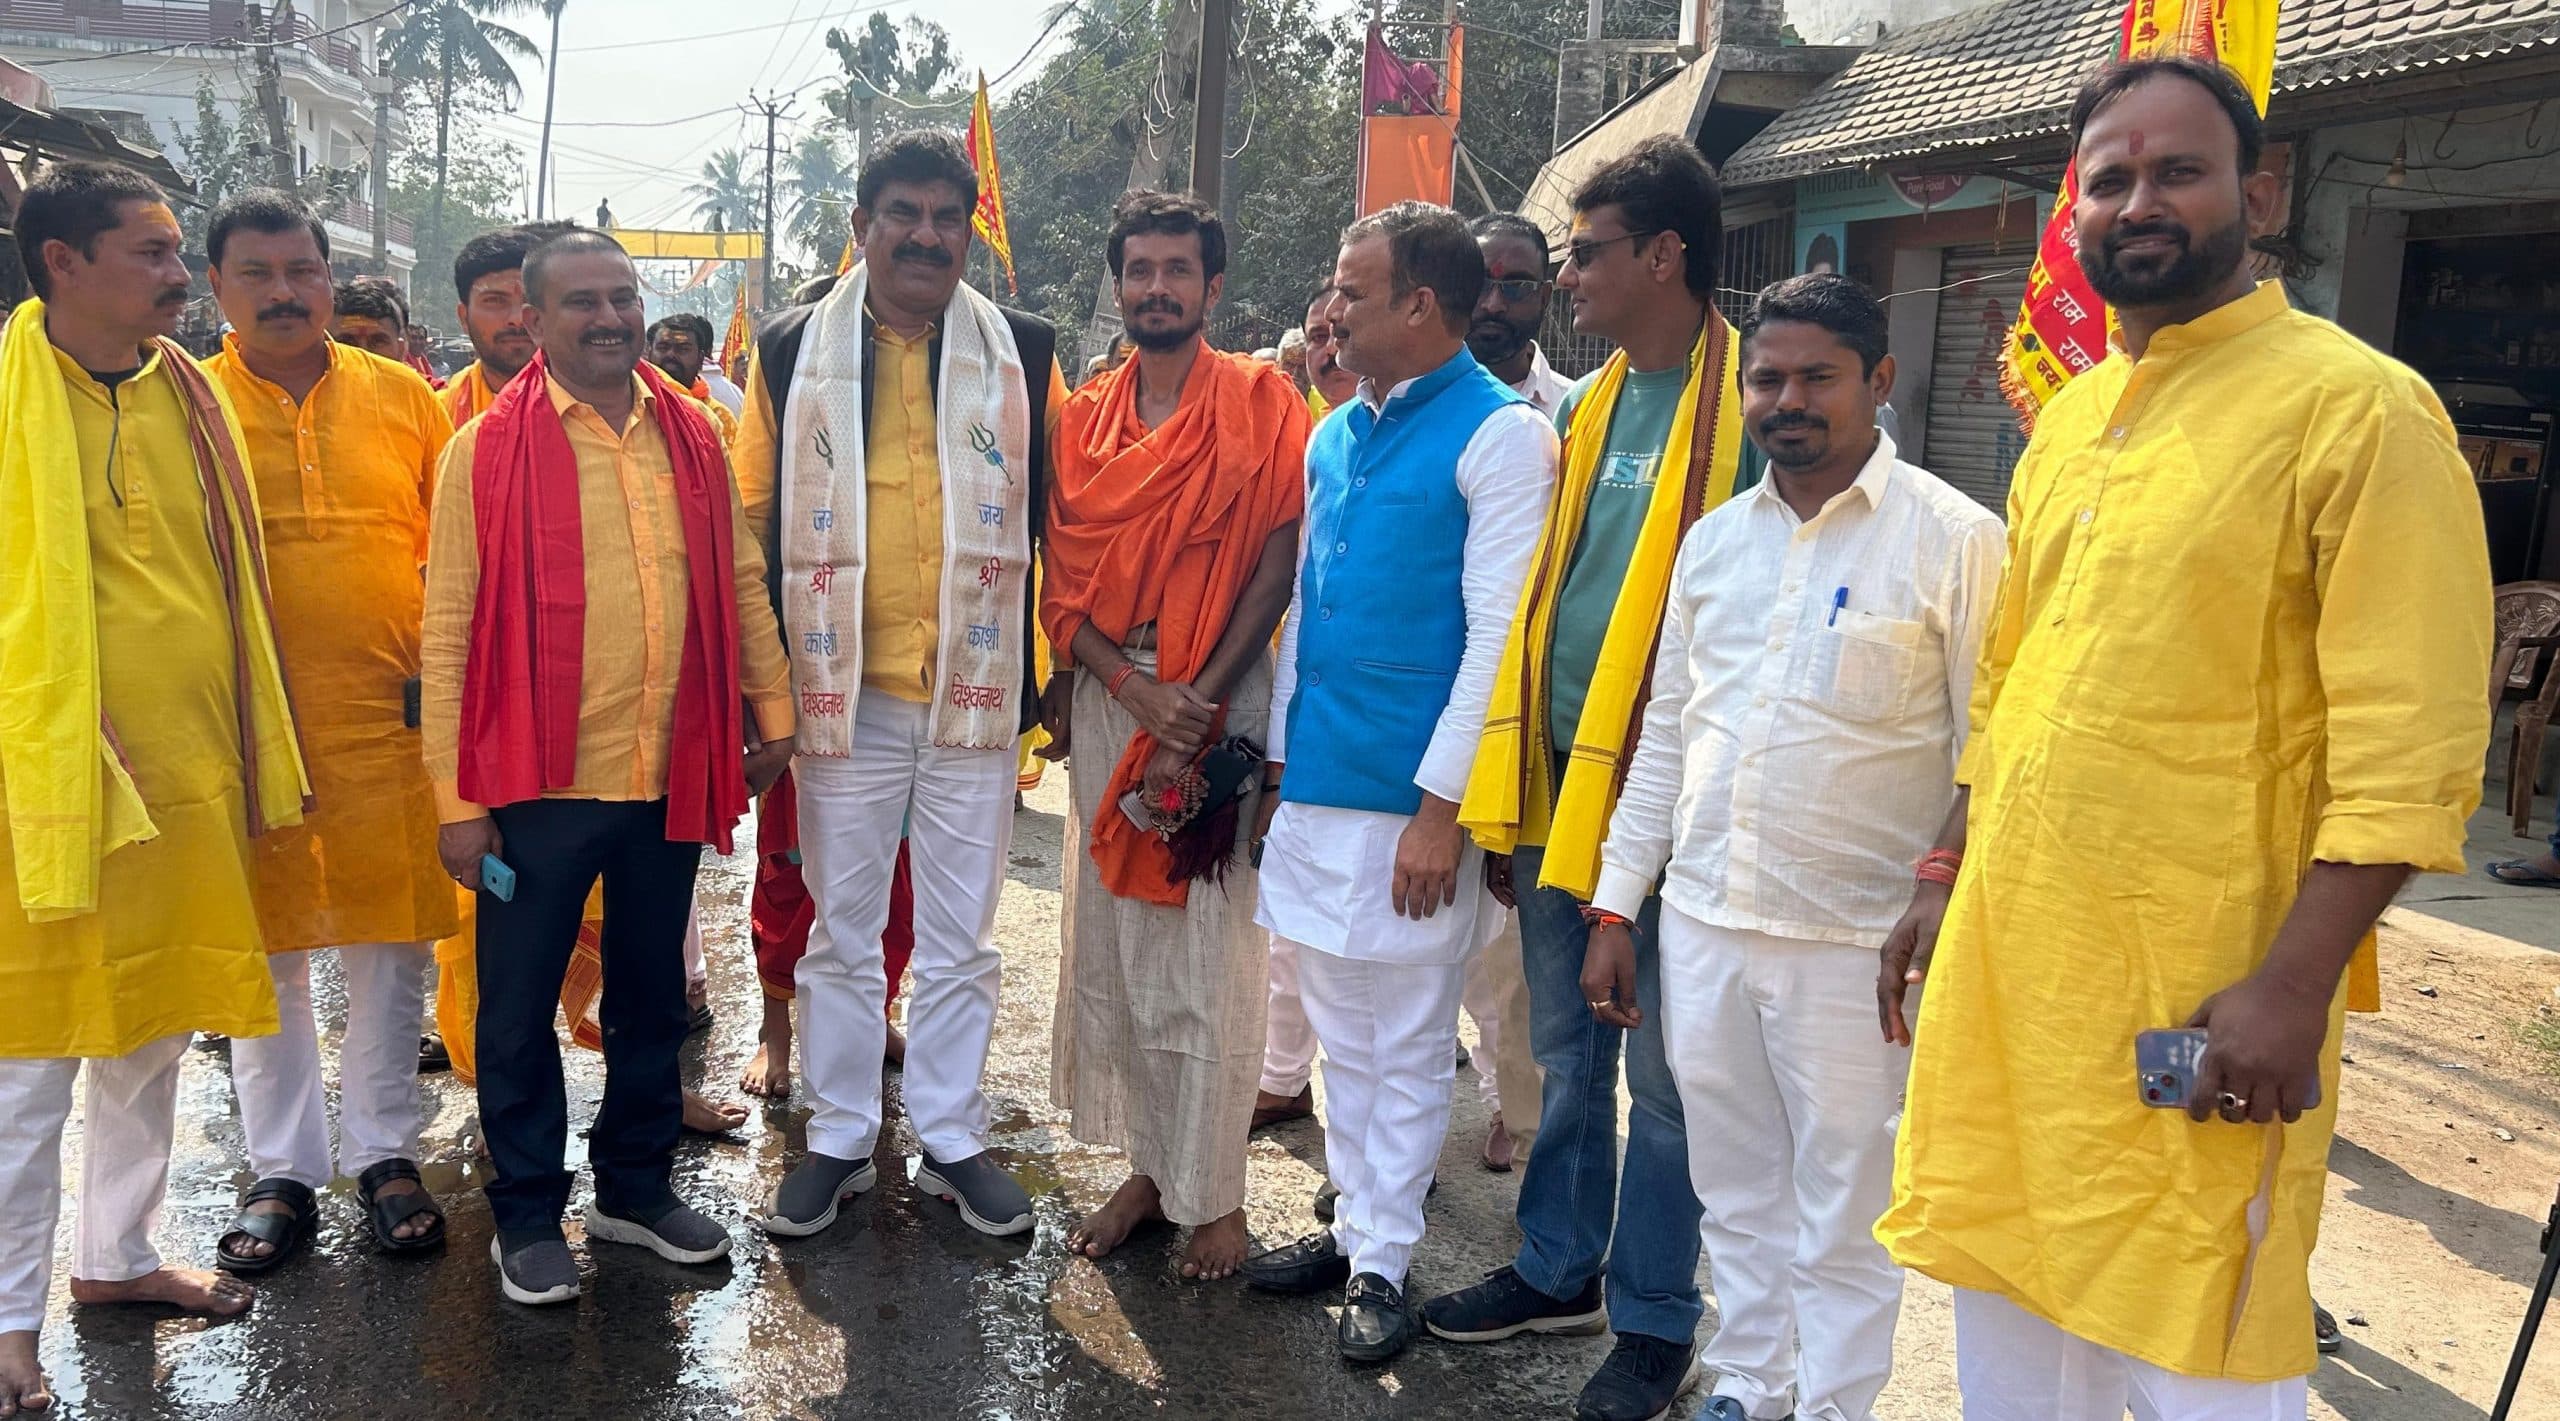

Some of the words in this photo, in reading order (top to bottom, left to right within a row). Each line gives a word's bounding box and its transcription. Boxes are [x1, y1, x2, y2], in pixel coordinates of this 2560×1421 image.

[2052, 288, 2088, 326] राम
[978, 503, 1006, 529] जय
[810, 562, 836, 595] श्री
[978, 556, 1005, 589] श्री
[803, 623, 838, 656] काशी
[967, 618, 1001, 650] काशी
[801, 682, 845, 718] विश्वनाथ
[949, 672, 1007, 712] विश्वनाथ
